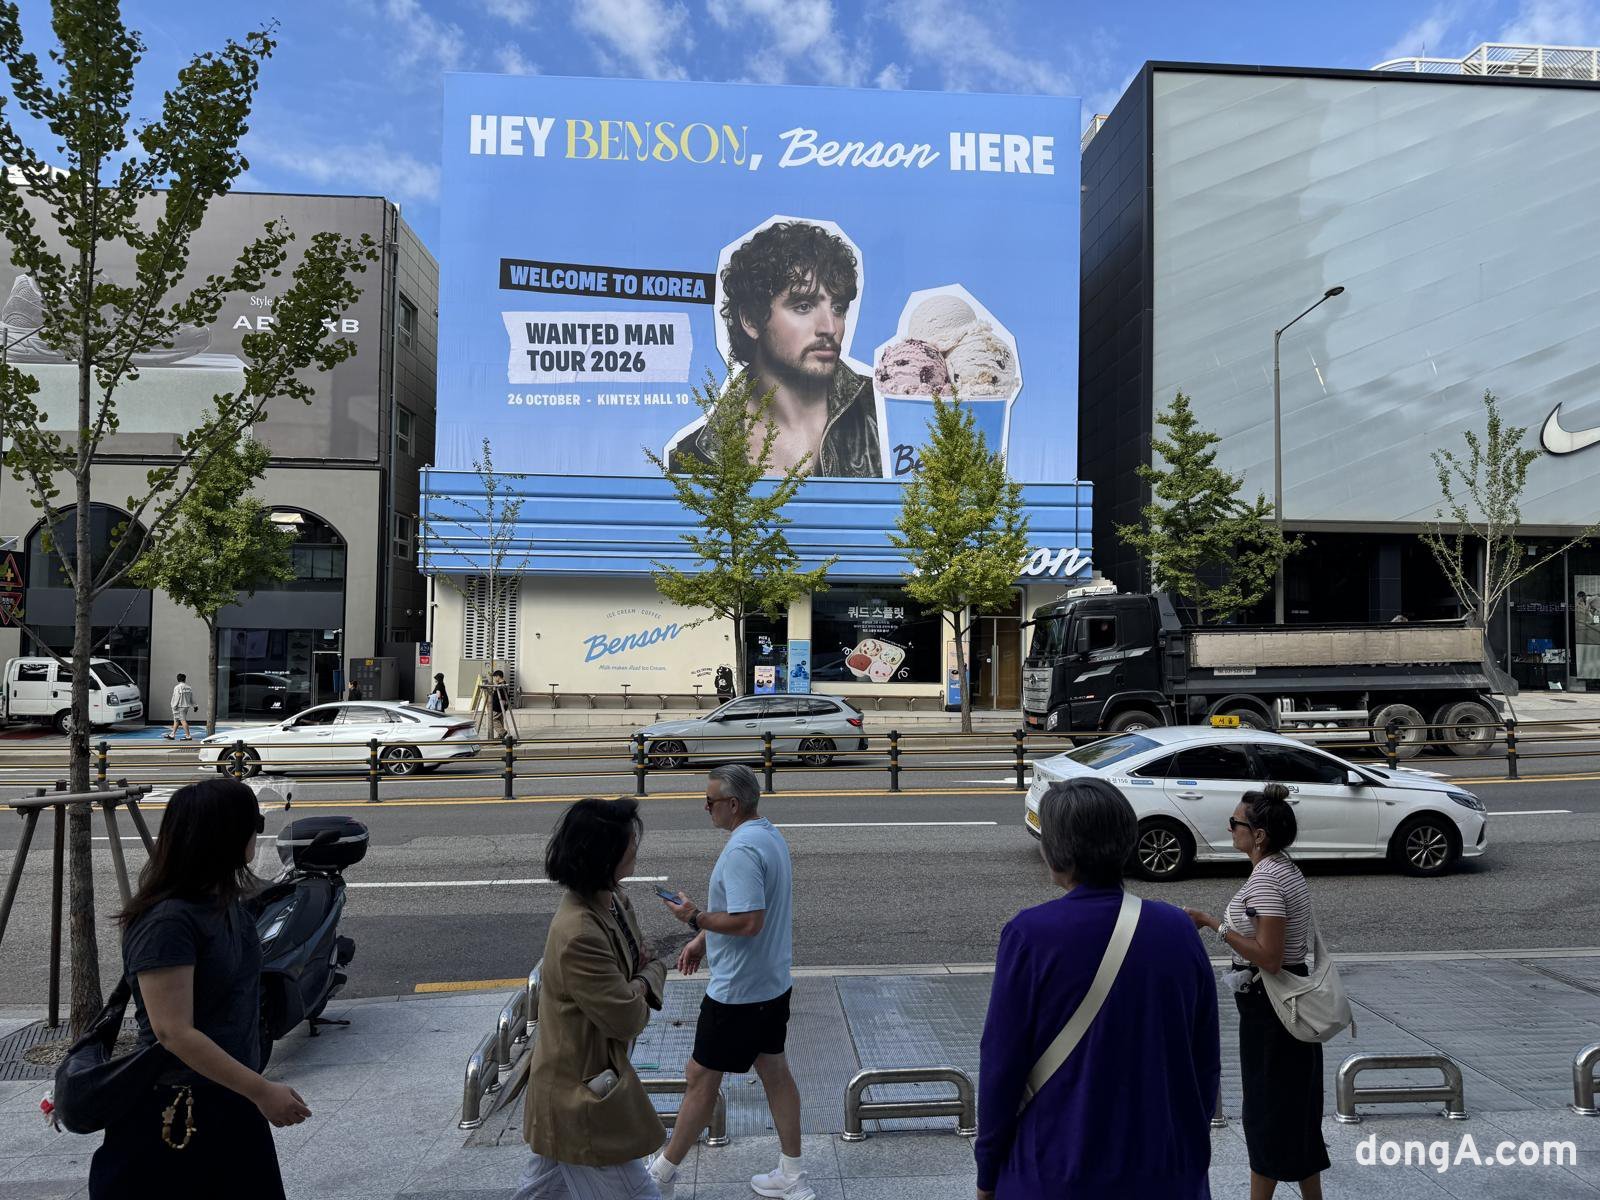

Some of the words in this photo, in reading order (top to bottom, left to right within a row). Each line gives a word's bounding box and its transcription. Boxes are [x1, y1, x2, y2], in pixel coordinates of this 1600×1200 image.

[469, 114, 556, 157] HEY
[564, 119, 763, 171] BENSON,
[778, 127, 940, 169] Benson
[950, 132, 1055, 175] HERE
[509, 265, 608, 292] WELCOME
[612, 274, 638, 295] TO
[642, 275, 707, 299] KOREA
[250, 295, 273, 309] Style
[232, 315, 360, 333] ABRB
[525, 322, 619, 345] WANTED
[624, 323, 675, 345] MAN
[526, 350, 586, 372] TOUR
[591, 351, 646, 373] 2026
[507, 393, 523, 405] 26
[526, 394, 581, 406] OCTOBER
[597, 394, 641, 406] KINTEX
[643, 394, 673, 405] HALL
[676, 393, 689, 405] 10
[617, 608, 636, 616] CREAM
[847, 606, 870, 619] 쿼드
[872, 606, 904, 619] 스플릿
[583, 622, 683, 663] Benson
